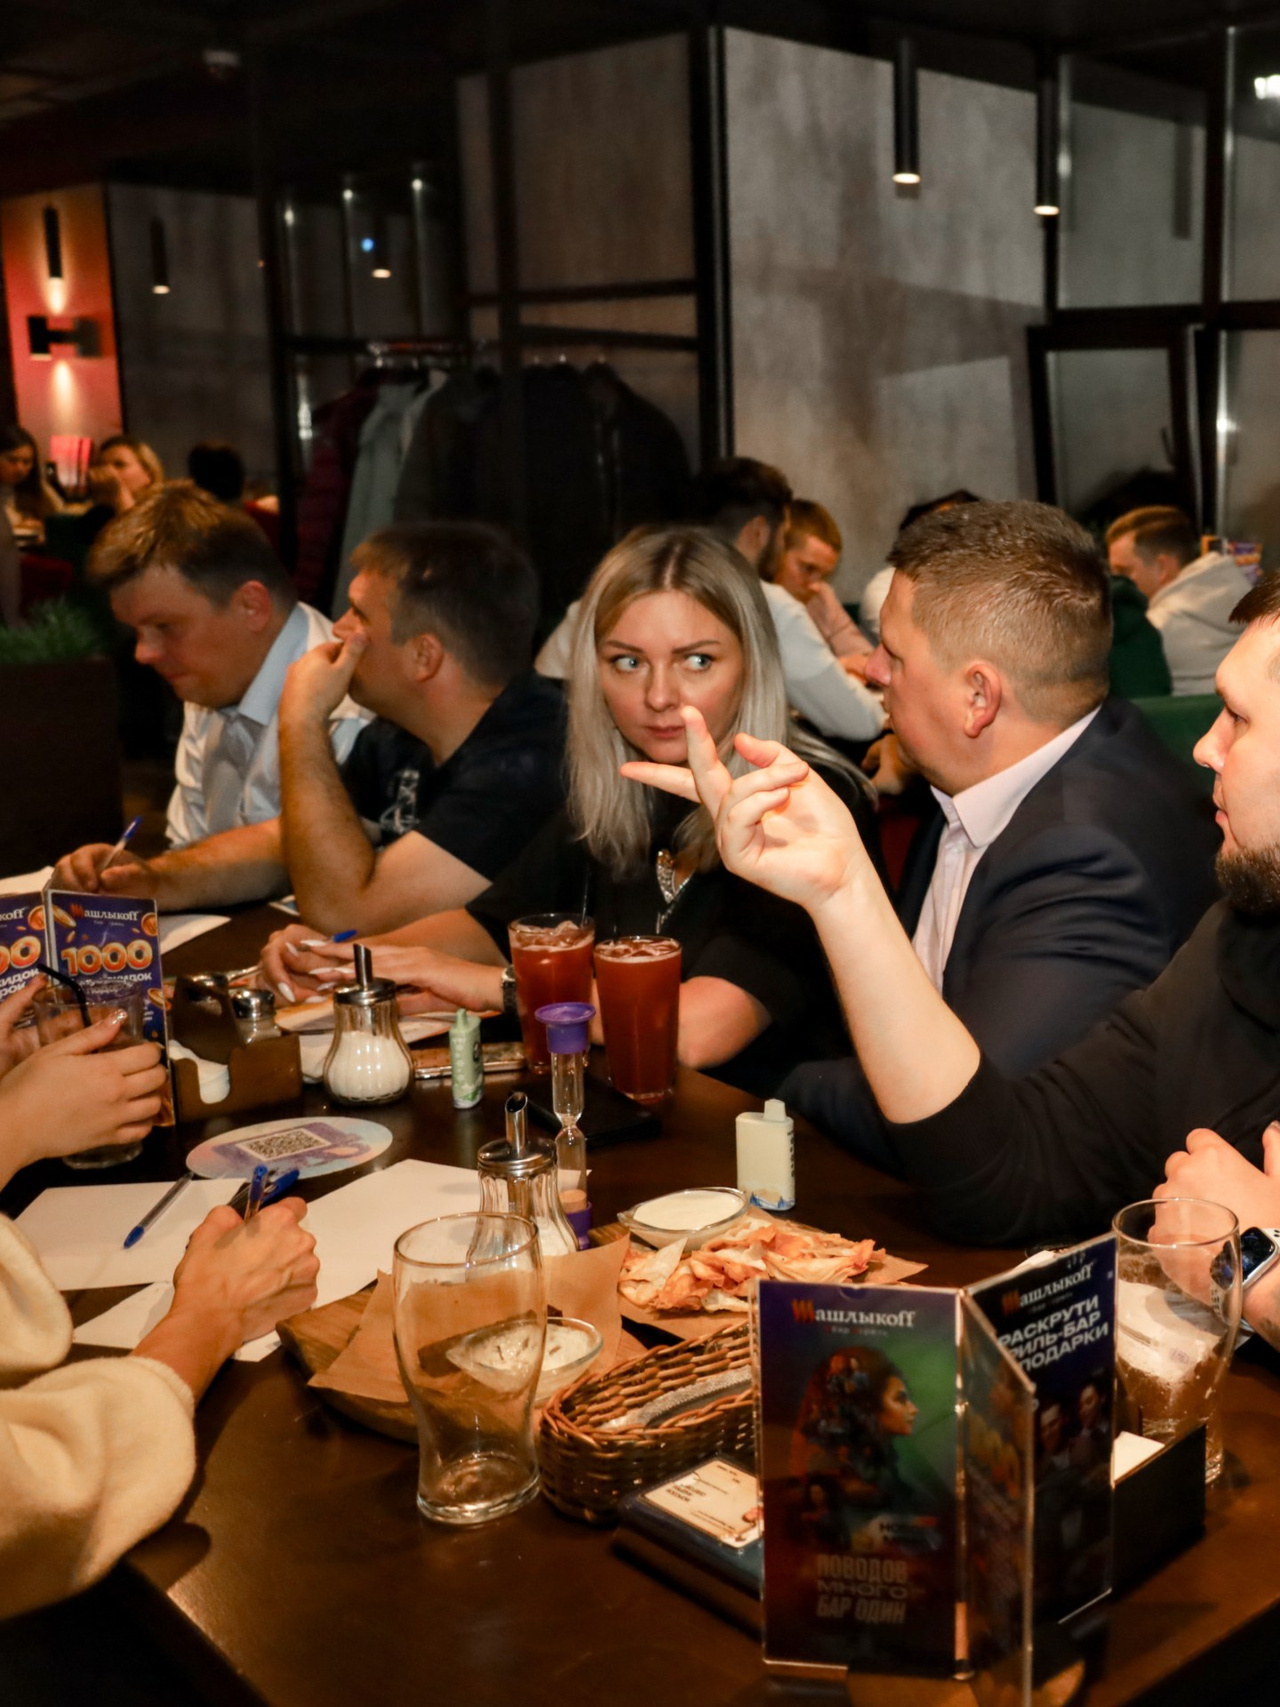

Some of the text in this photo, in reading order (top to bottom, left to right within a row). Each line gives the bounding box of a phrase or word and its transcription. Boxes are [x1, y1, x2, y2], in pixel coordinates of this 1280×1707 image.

[61, 939, 153, 976] 1000
[999, 1295, 1099, 1346] РАСКРУТИ
[1008, 1311, 1101, 1359] РИЛЬ-БАР
[816, 1553, 909, 1584] ПОВОДОВ
[816, 1596, 907, 1625] БАР ОДИН
